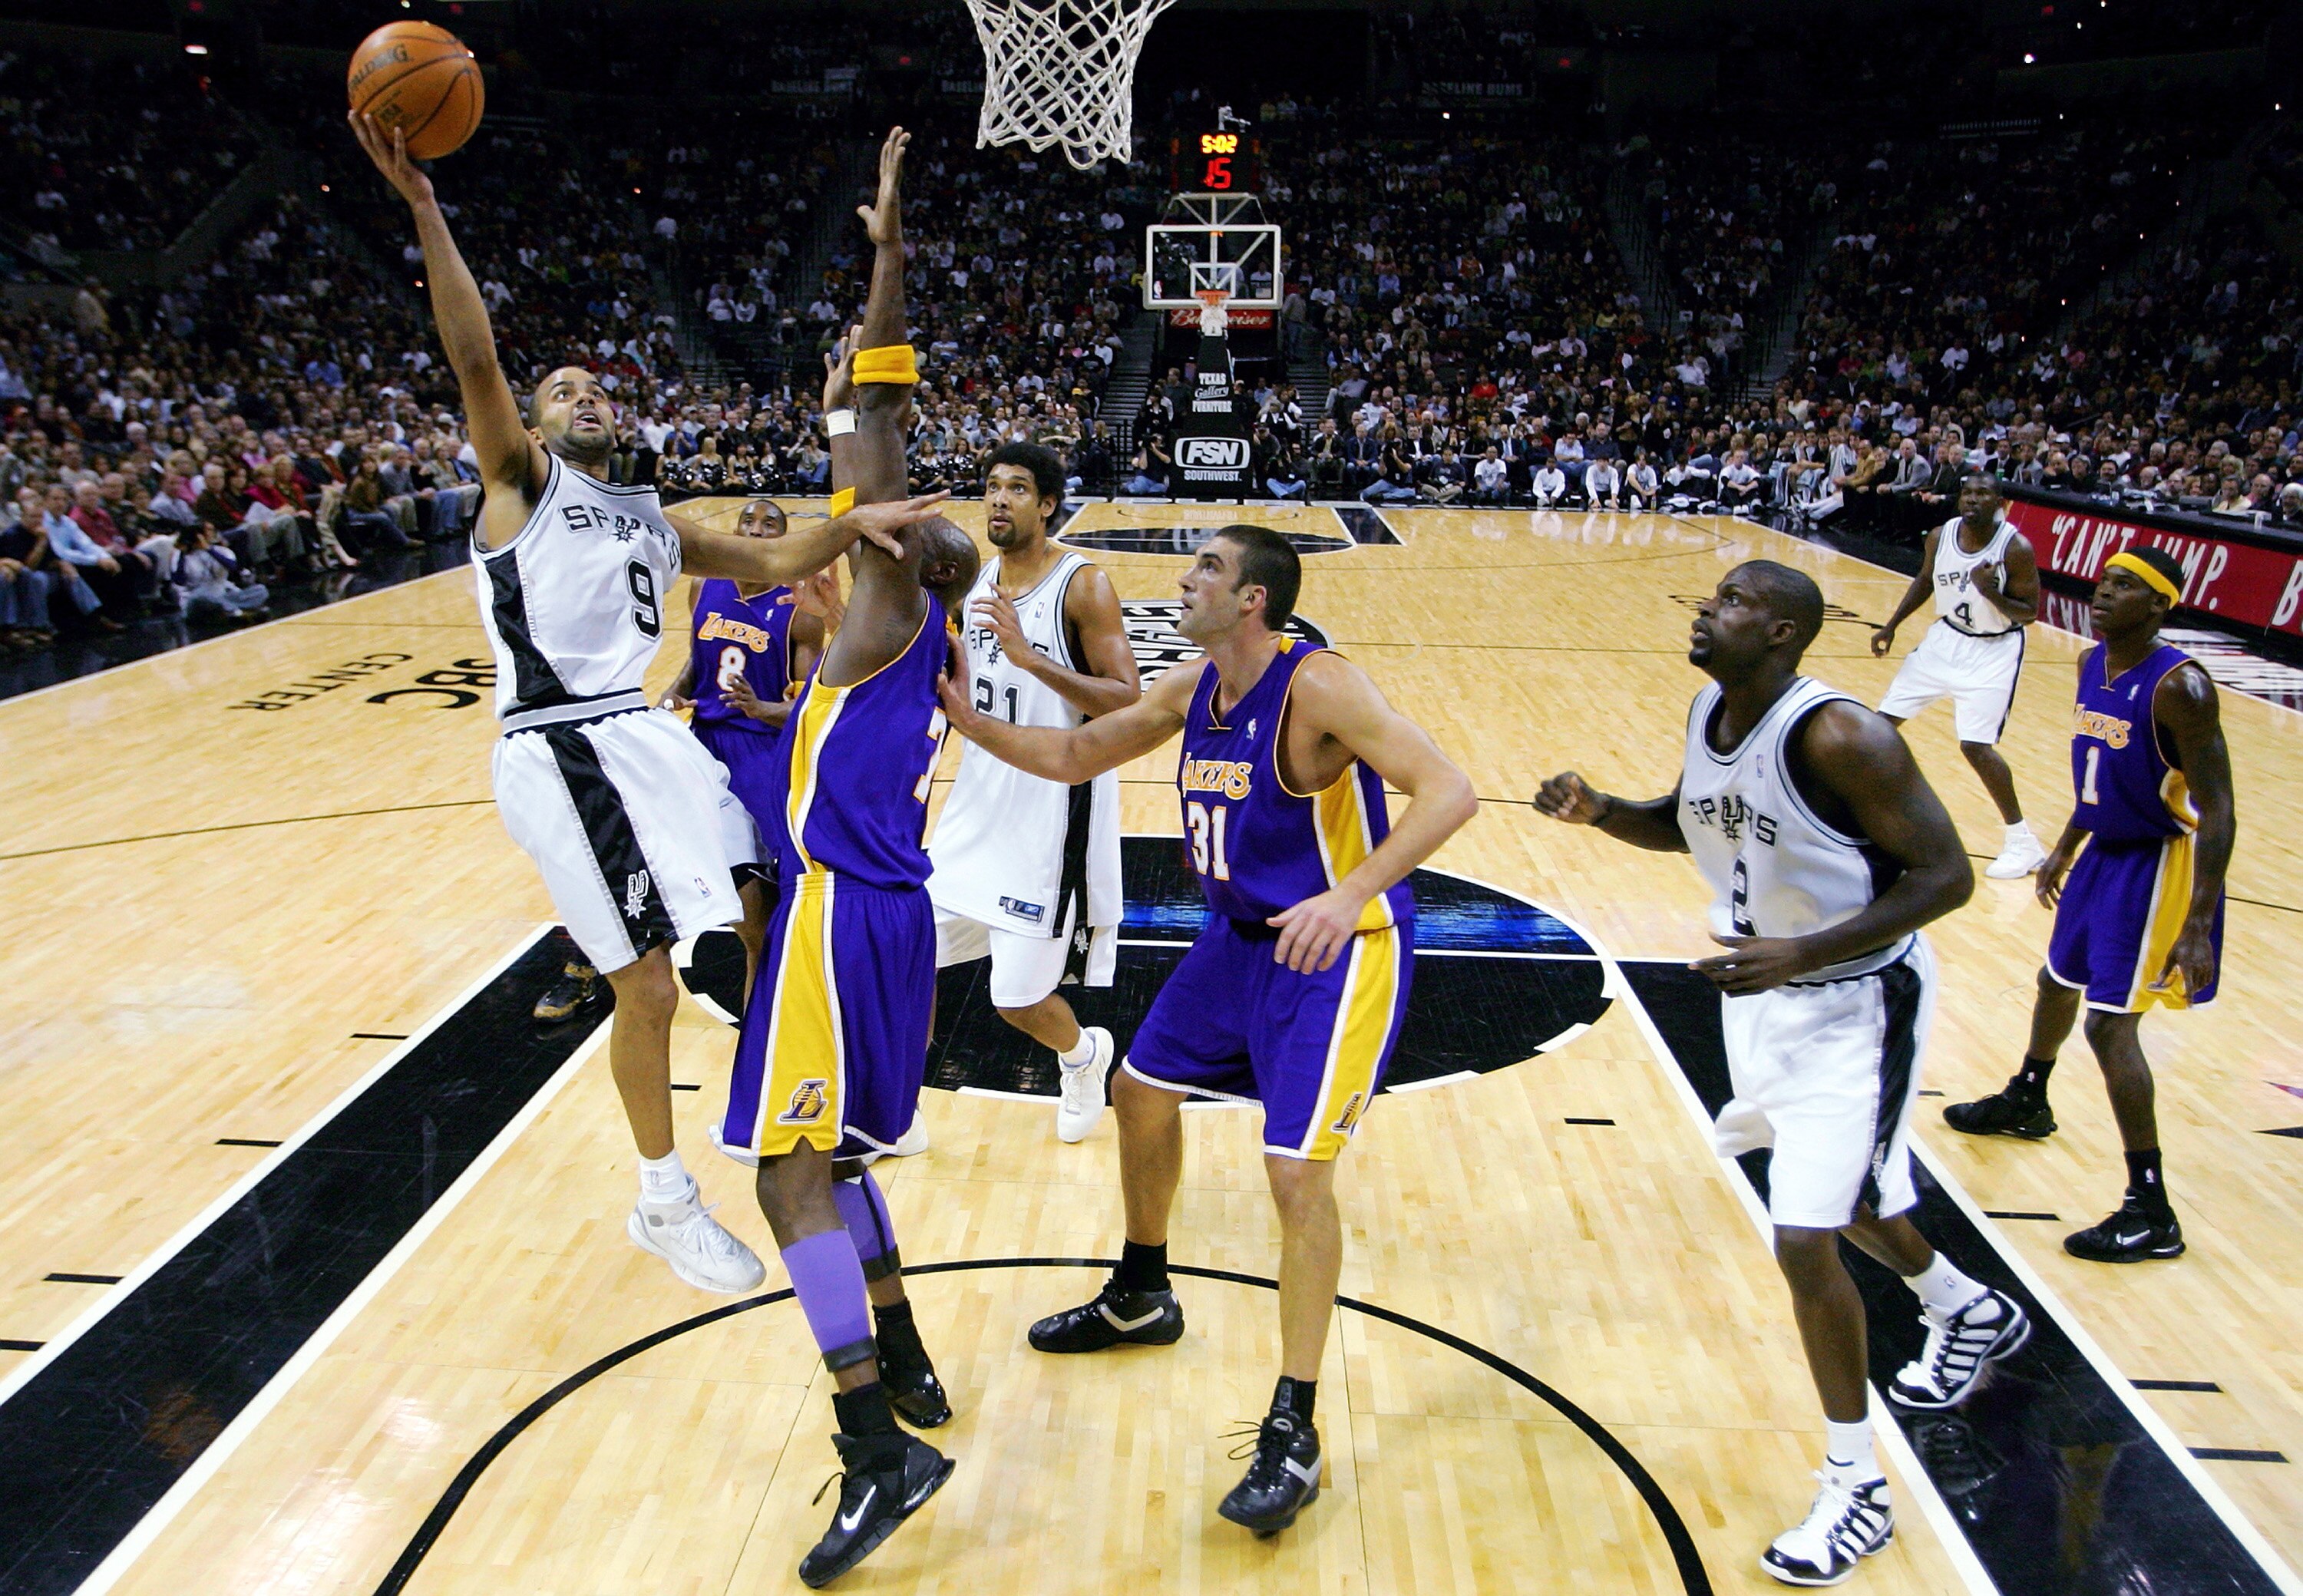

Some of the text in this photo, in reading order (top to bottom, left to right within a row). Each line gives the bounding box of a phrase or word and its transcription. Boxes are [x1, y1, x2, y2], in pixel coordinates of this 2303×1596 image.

[1201, 134, 1238, 154] 5:02
[1202, 157, 1232, 189] 15
[1194, 385, 1230, 401] Gallery
[1198, 372, 1227, 385] TEXAS
[1192, 400, 1233, 413] FURNITURE
[1186, 441, 1240, 465] FSN
[625, 555, 663, 642] 9
[1954, 602, 1974, 629] 4
[698, 611, 771, 653] LAKERS
[226, 653, 414, 712] CENTER
[716, 646, 746, 692] 8
[974, 676, 1019, 725] 21
[2081, 745, 2100, 805] 1
[1188, 801, 1230, 881] 31
[1732, 856, 1760, 937] 2
